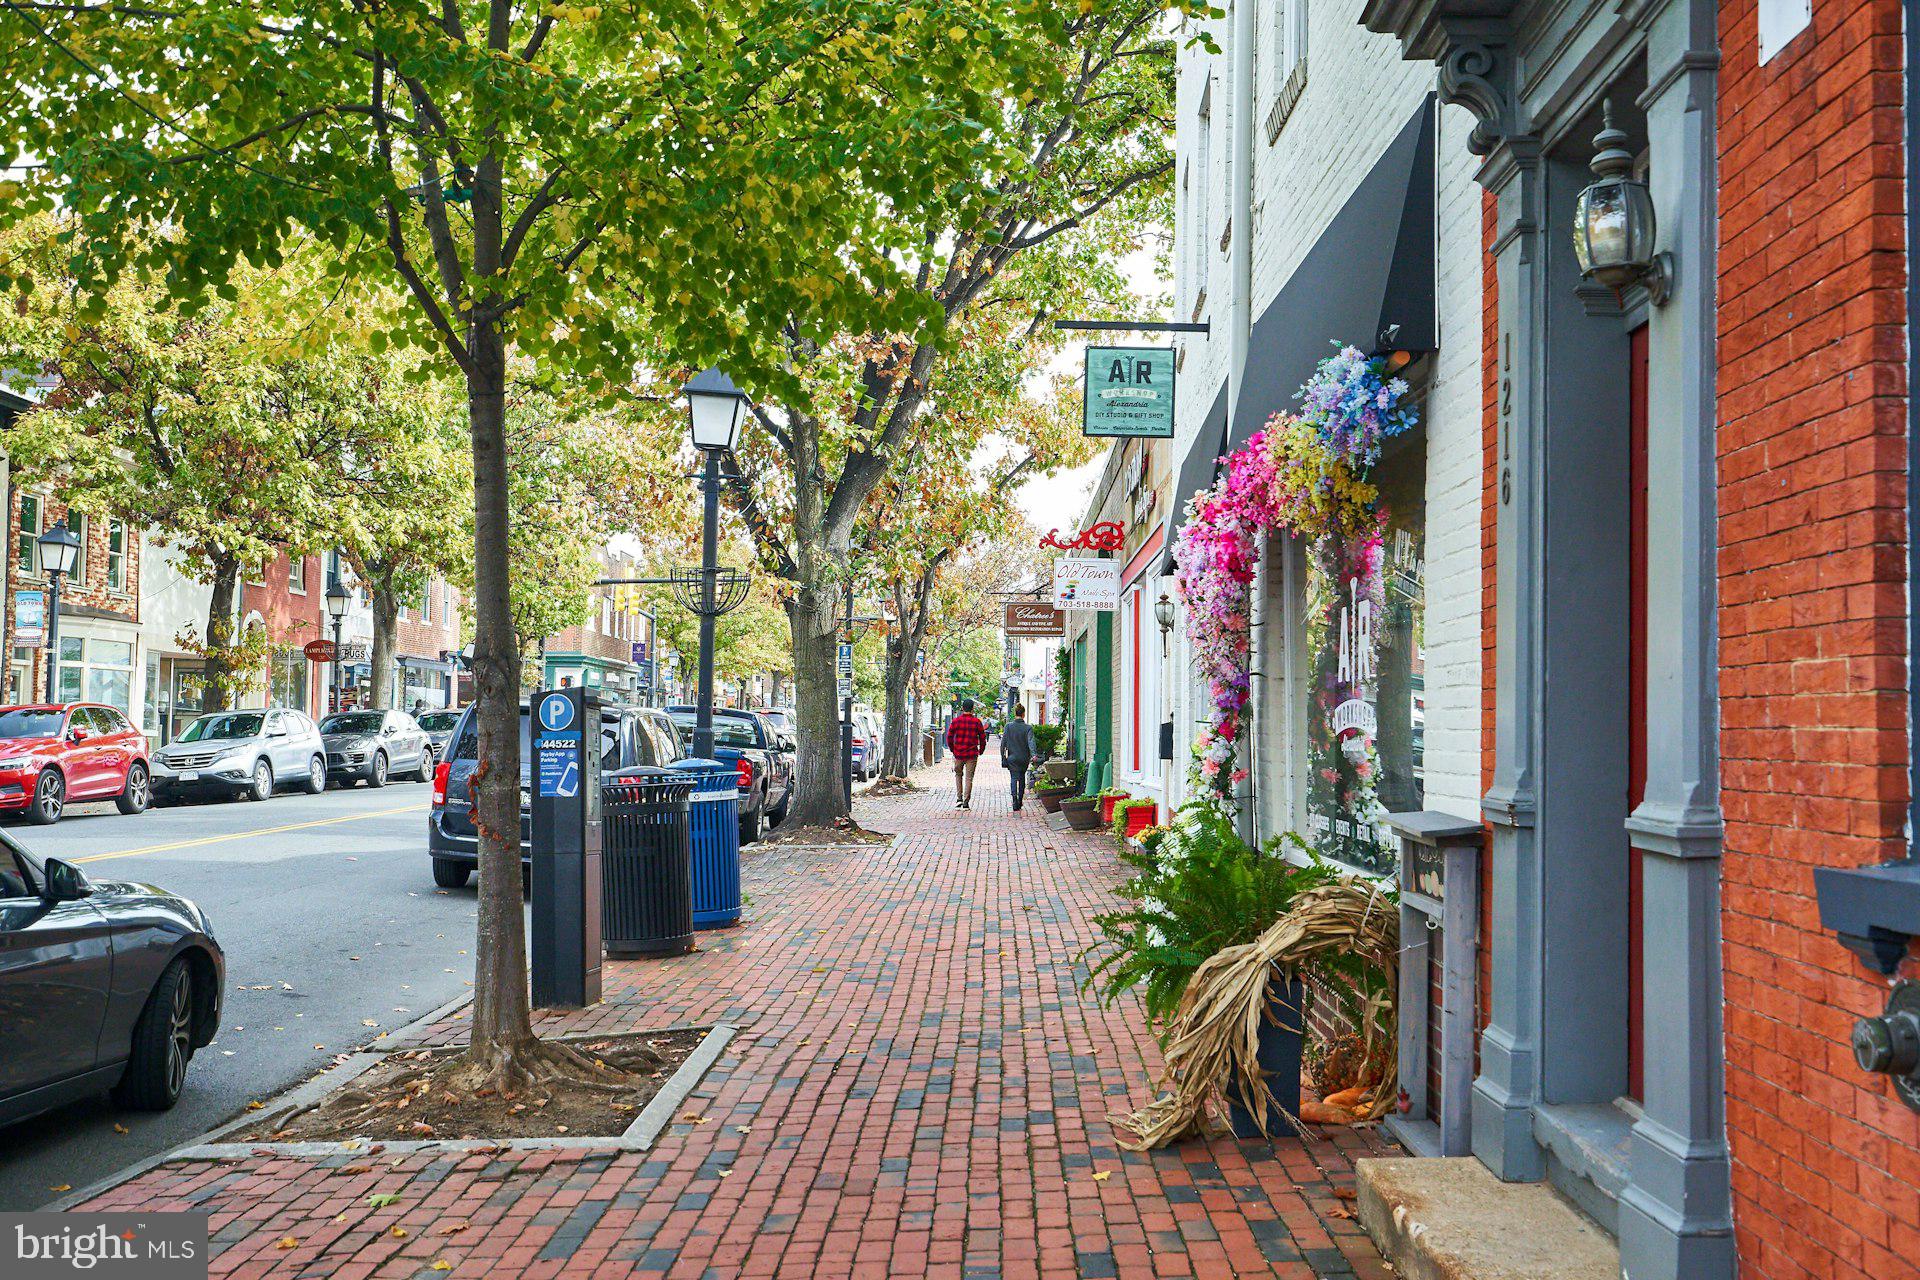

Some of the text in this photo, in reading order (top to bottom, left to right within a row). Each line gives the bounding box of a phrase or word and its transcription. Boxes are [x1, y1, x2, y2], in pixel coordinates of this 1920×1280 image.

[1105, 388, 1154, 398] WORKSHOP
[1106, 400, 1149, 408] Alexandria
[1501, 332, 1512, 506] 1216
[1057, 562, 1114, 579] Old Town
[1058, 601, 1114, 609] 703-518-8888
[549, 700, 565, 725] P
